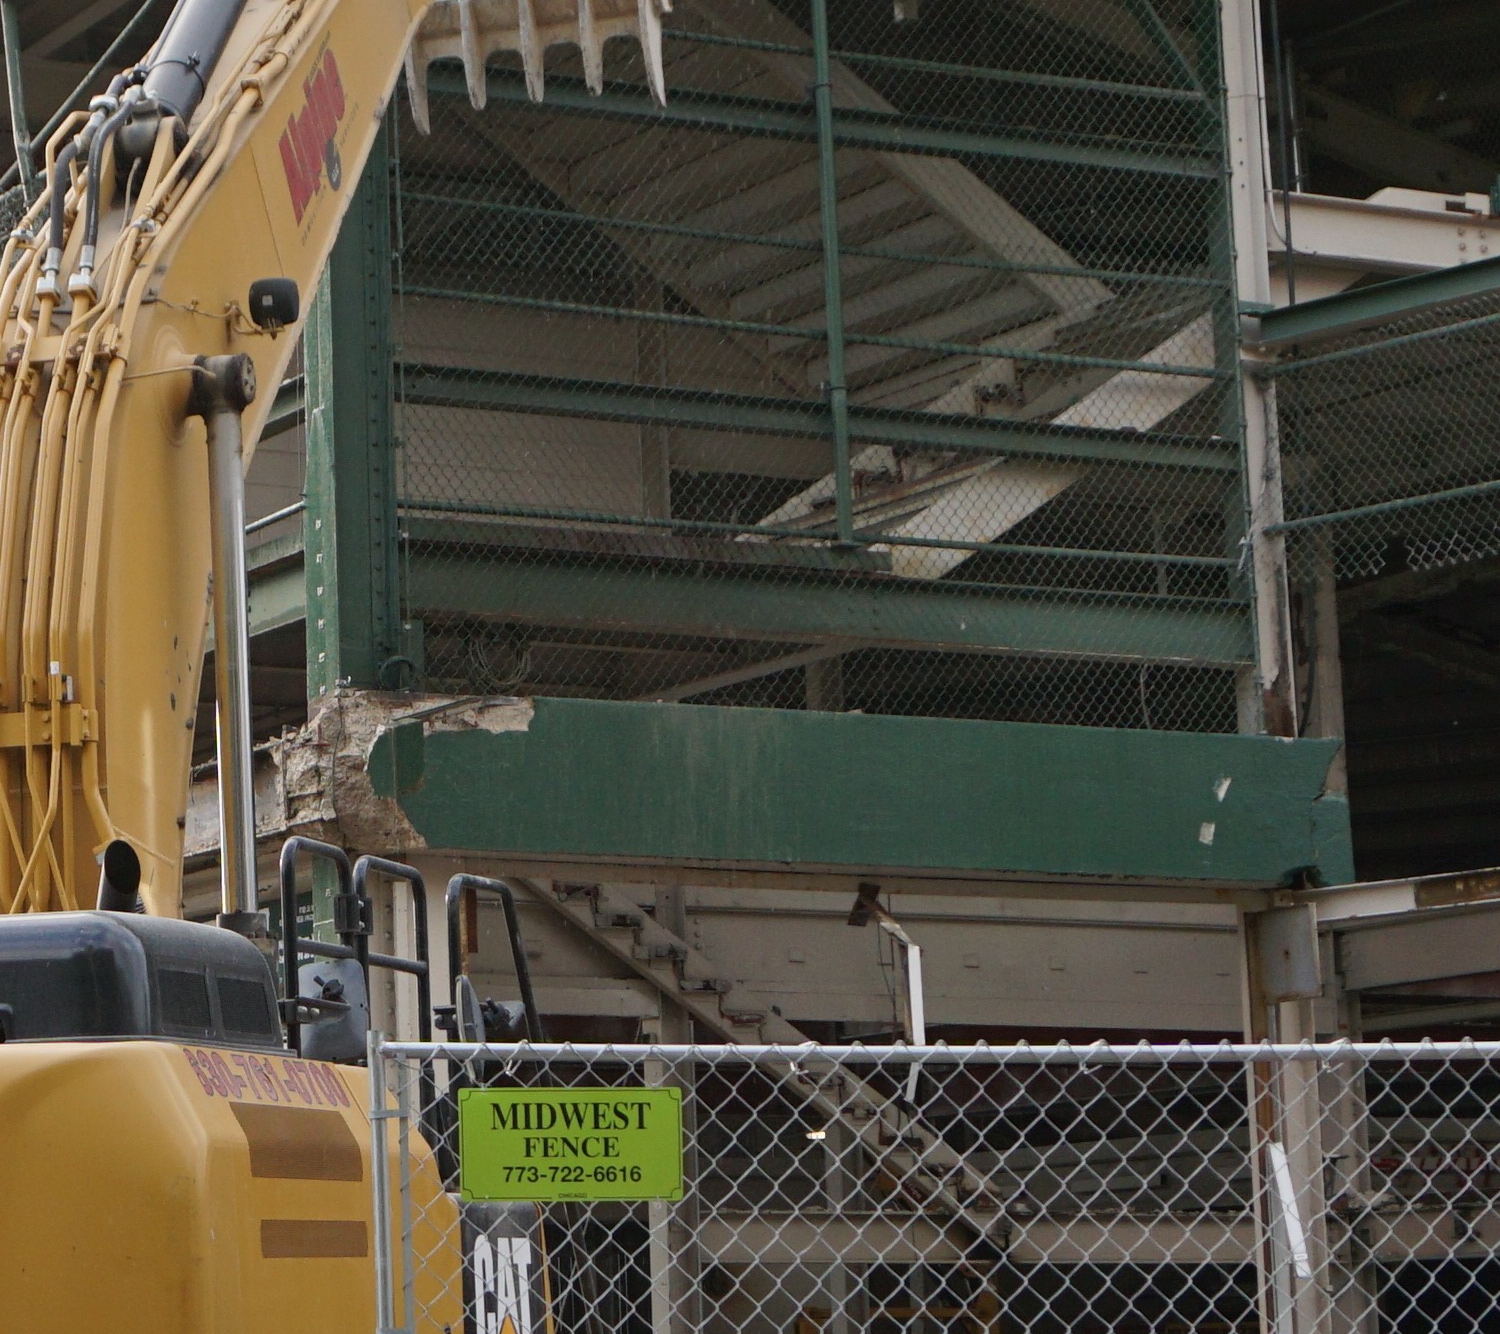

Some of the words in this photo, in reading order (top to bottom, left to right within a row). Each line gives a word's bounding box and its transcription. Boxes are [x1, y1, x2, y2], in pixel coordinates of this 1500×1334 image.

[490, 1102, 651, 1131] MIDWEST
[523, 1137, 620, 1158] FENCE
[503, 1166, 642, 1183] 773-722-6616
